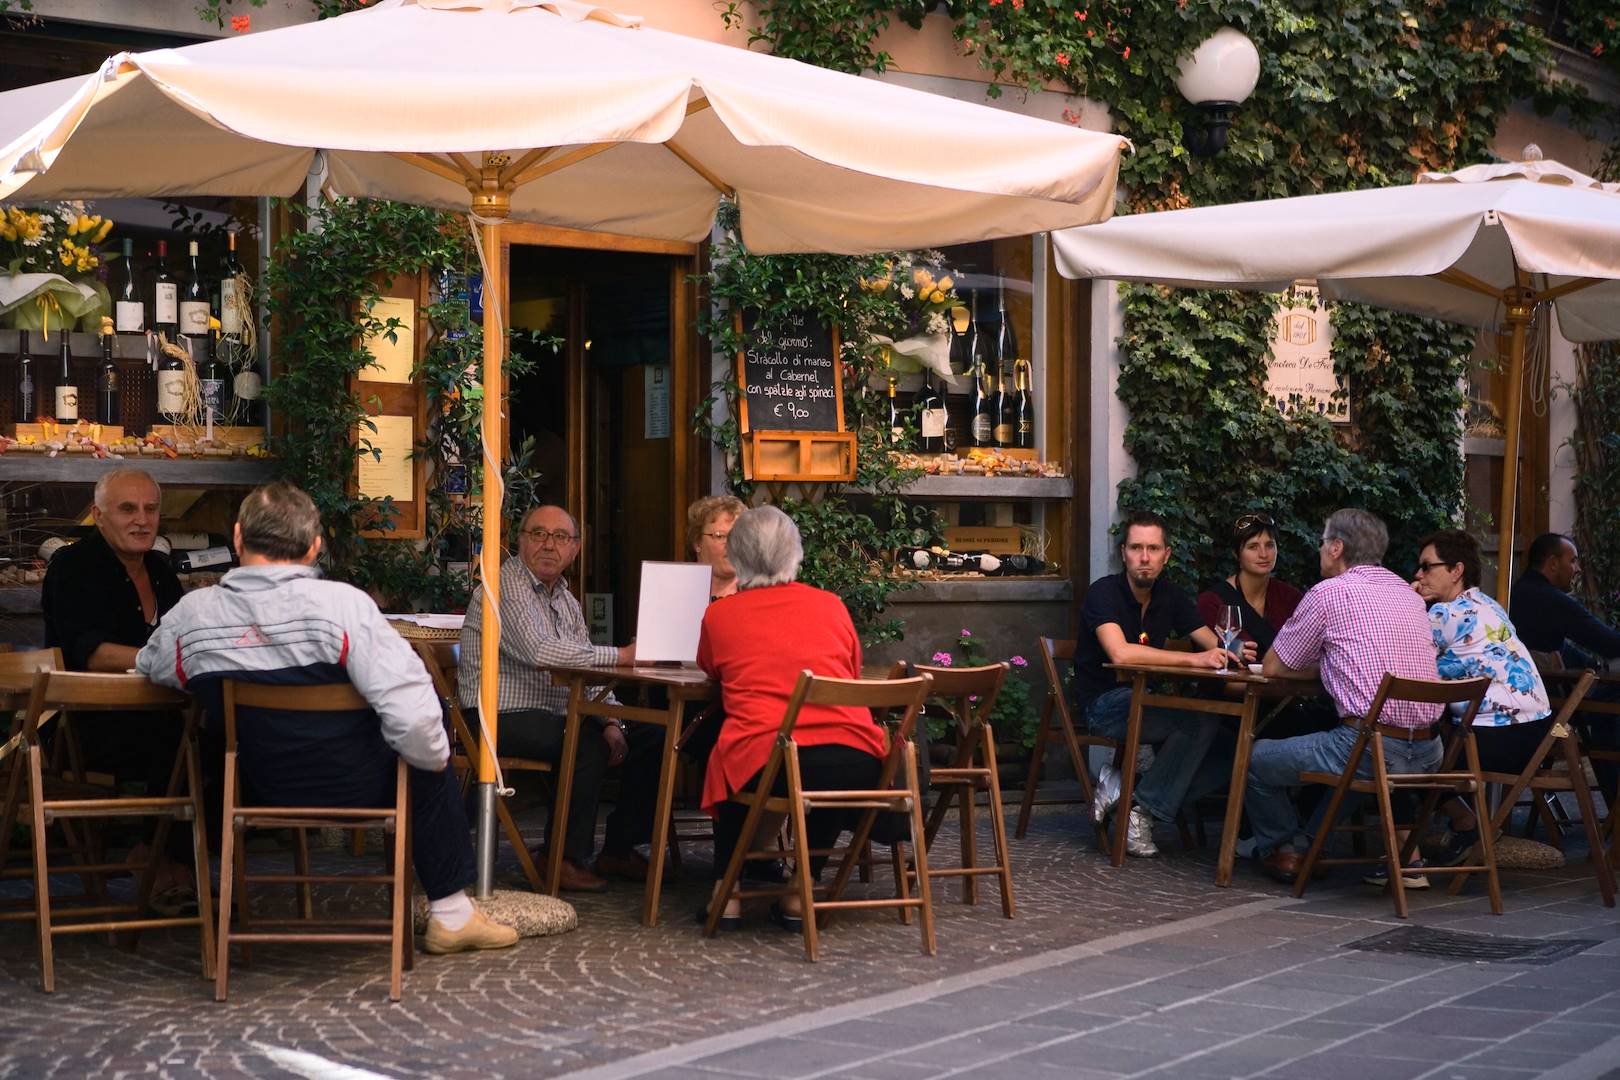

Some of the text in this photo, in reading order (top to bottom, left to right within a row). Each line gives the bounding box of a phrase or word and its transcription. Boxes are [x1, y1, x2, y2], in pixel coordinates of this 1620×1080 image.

[778, 331, 813, 350] giorno:
[792, 354, 801, 366] di
[804, 357, 832, 368] manzo
[766, 368, 773, 380] al
[747, 384, 762, 395] con
[795, 385, 807, 401] agli
[774, 402, 810, 419] € 9,00
